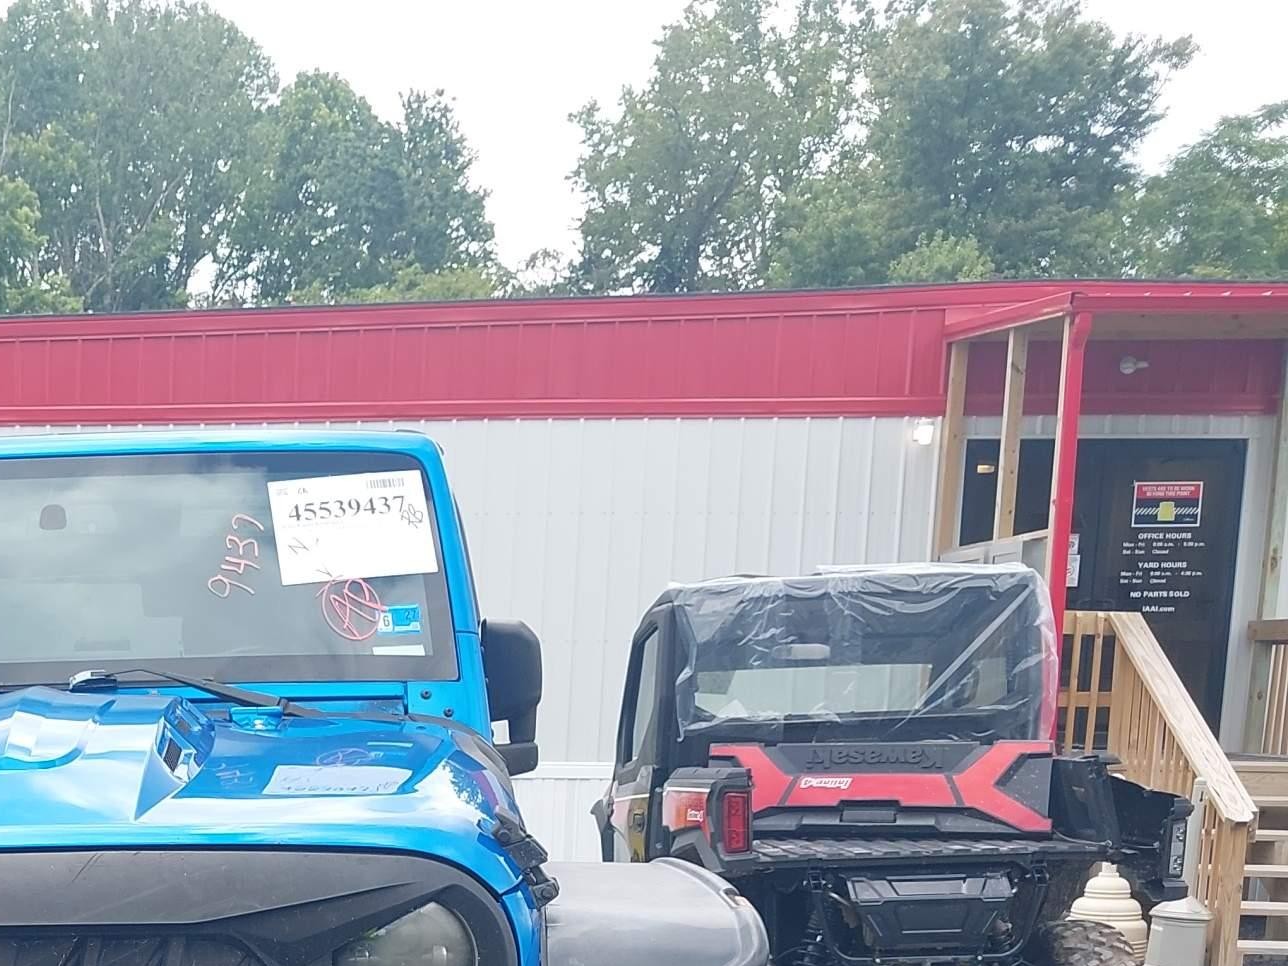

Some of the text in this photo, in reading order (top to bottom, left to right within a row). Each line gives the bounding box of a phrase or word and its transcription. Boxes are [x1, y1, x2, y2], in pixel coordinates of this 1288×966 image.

[288, 495, 405, 521] 45539437
[1138, 532, 1164, 540] OFFICE
[207, 513, 264, 598] 9437
[806, 746, 943, 769] Kawasaki
